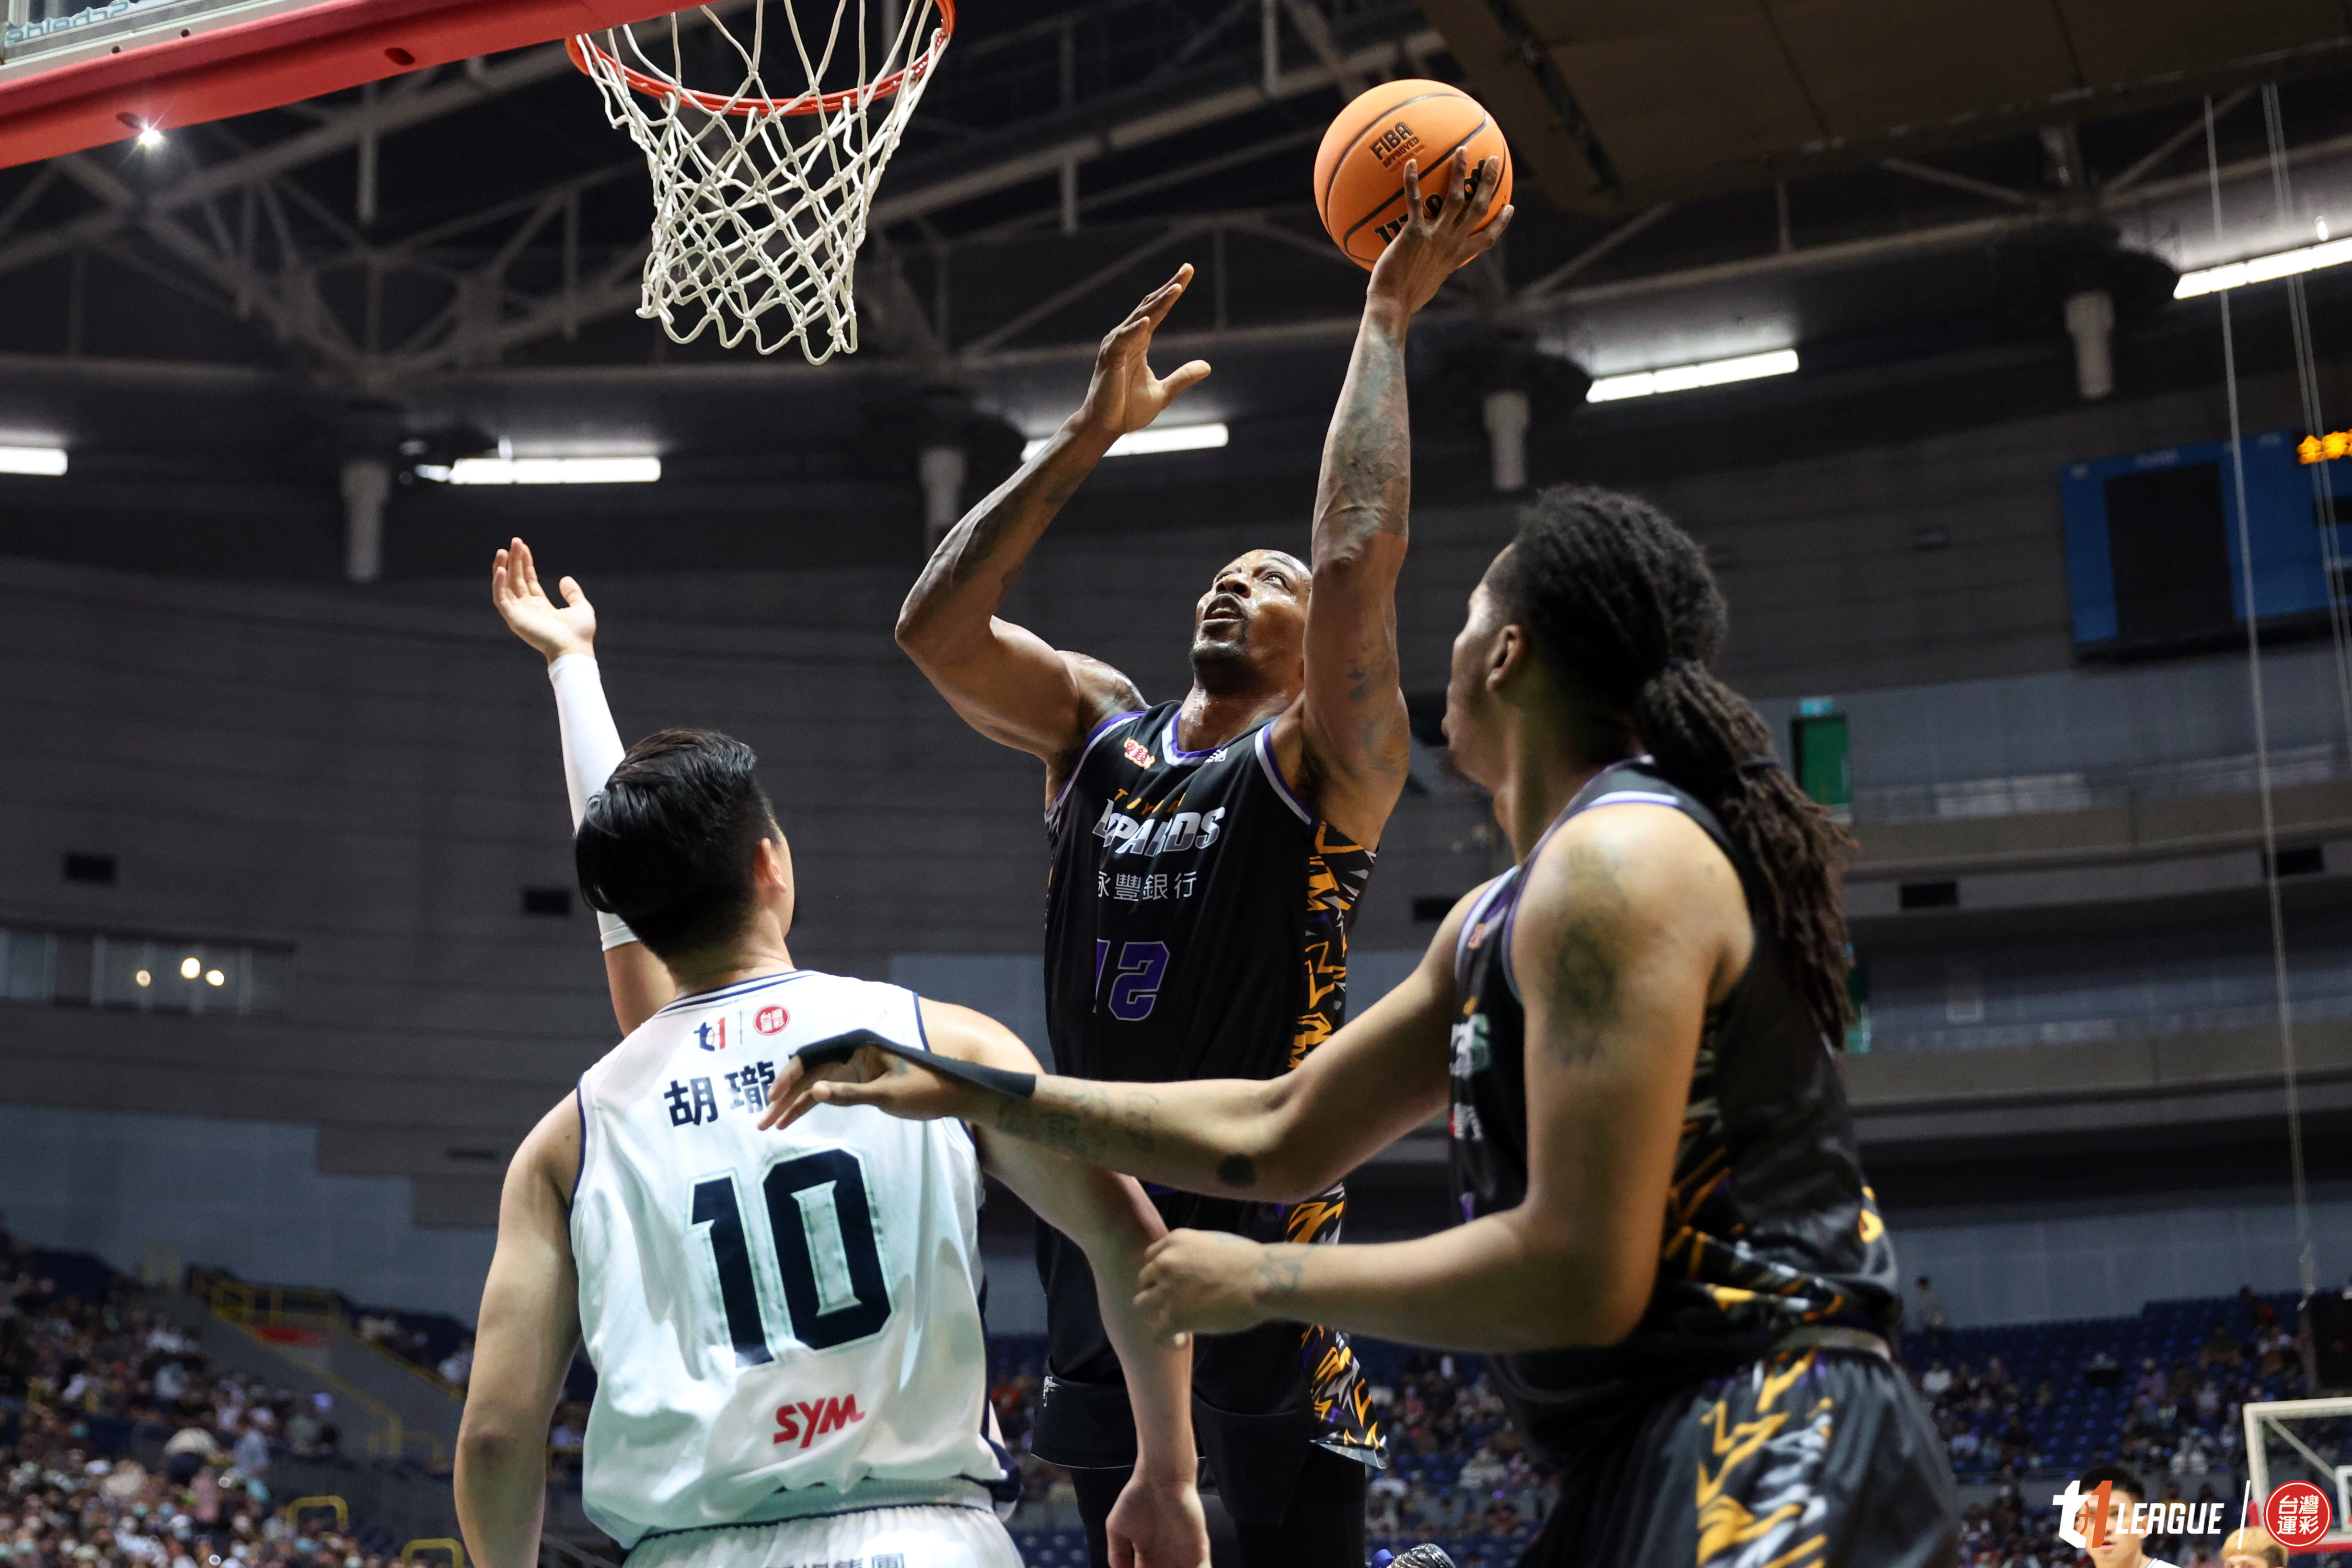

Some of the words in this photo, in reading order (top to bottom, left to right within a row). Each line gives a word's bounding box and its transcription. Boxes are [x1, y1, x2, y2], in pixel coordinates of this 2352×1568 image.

[1370, 123, 1413, 160] FIBA
[1383, 137, 1419, 168] APPROVED
[664, 1058, 781, 1127] 胡瓏
[689, 1146, 894, 1369] 10
[773, 1393, 865, 1449] SYM
